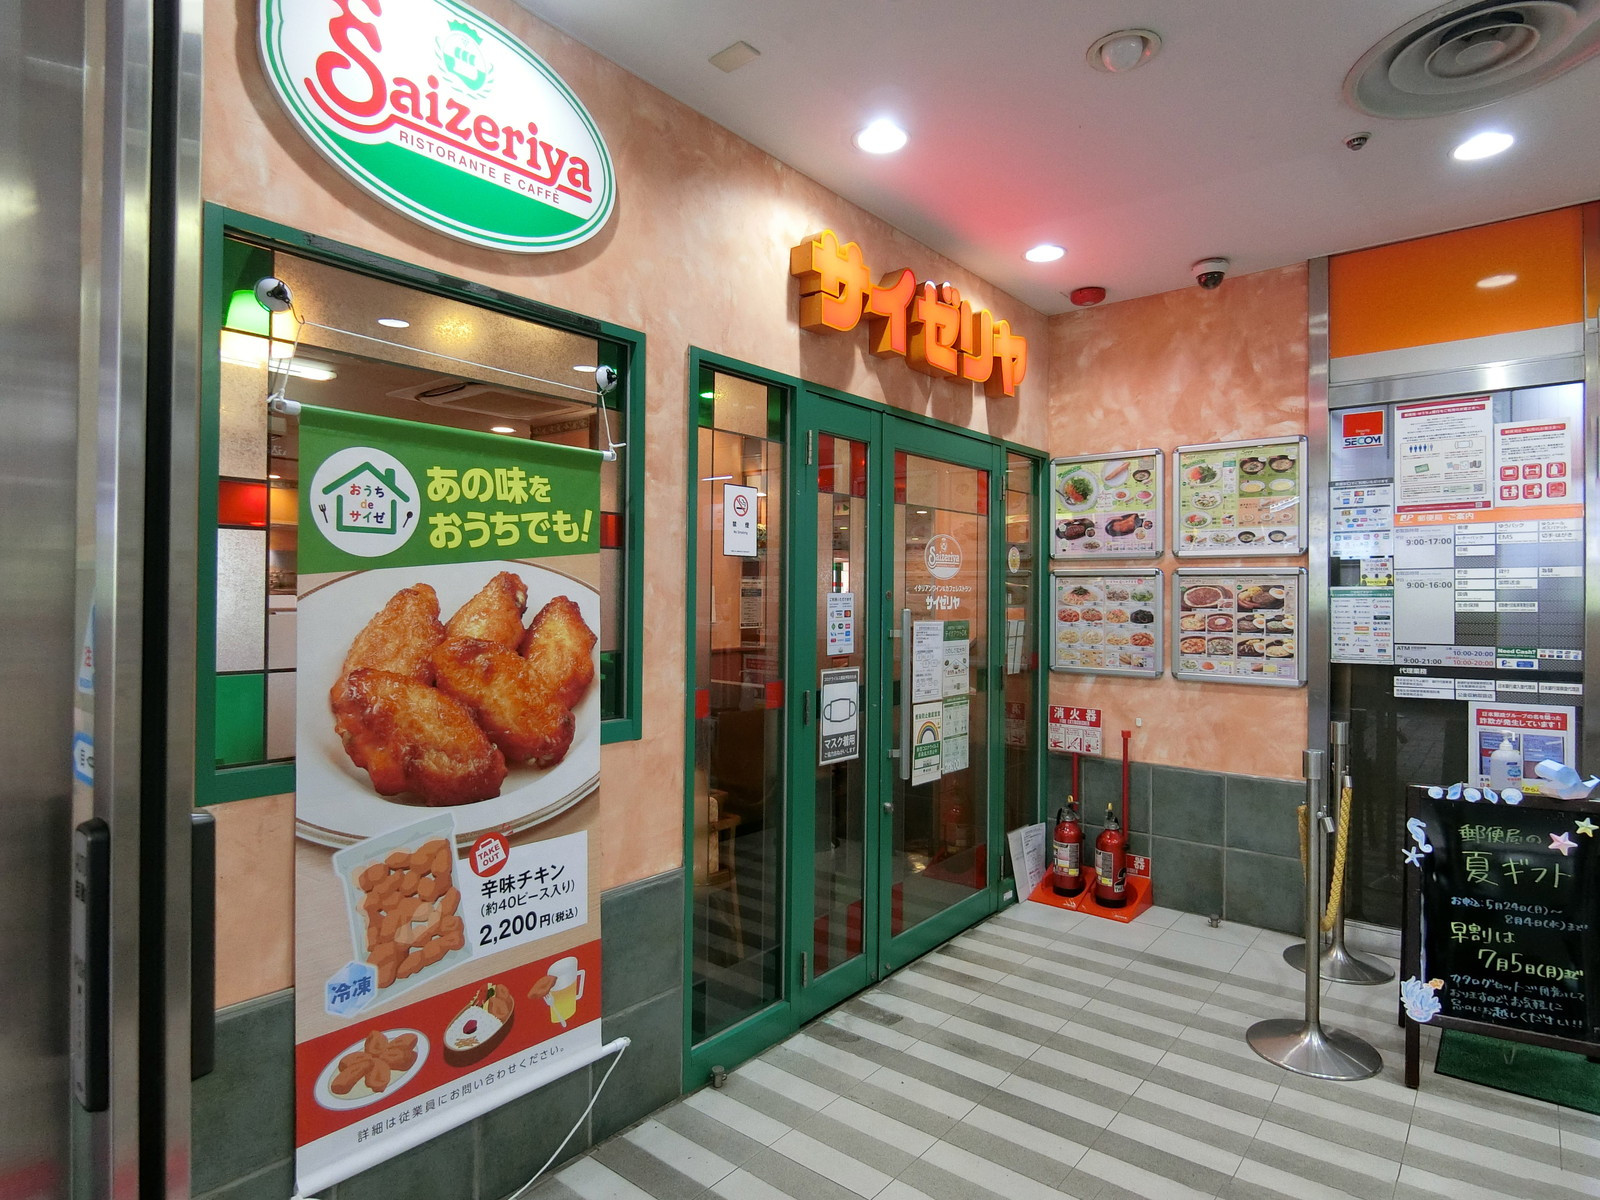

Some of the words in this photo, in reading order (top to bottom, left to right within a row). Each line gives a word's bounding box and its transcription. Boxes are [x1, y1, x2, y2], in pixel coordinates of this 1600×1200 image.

[310, 0, 592, 200] Saizeriya
[399, 130, 497, 179] RISTORANTE
[503, 172, 512, 185] E
[517, 178, 560, 205] CAFFÈ
[790, 229, 1028, 397] サイゼリヤ
[1344, 435, 1381, 447] SECOM
[349, 483, 385, 499] おうち
[426, 465, 552, 505] あの味を
[360, 498, 374, 510] de
[349, 510, 386, 524] サイゼ
[1448, 512, 1475, 520] ご案内
[1406, 538, 1452, 546] 9:00-17:00
[928, 546, 960, 567] Saizeriya
[1406, 581, 1453, 589] 9:00-16:00
[925, 595, 960, 610] サイゼリヤ
[1403, 657, 1442, 665] 9:00-21:00
[1053, 707, 1097, 722] 消火器
[824, 734, 855, 749] マスク着用
[1458, 824, 1542, 845] 郵便局の
[477, 843, 501, 860] TAKE
[482, 852, 500, 867] OUT
[1462, 851, 1572, 888] 夏ギフト
[480, 864, 565, 899] 辛味チキン
[1451, 922, 1516, 944] 早割は
[331, 976, 372, 1005] 冷凍
[357, 1045, 566, 1144] 詳細は従業員にお問い合わせください。
